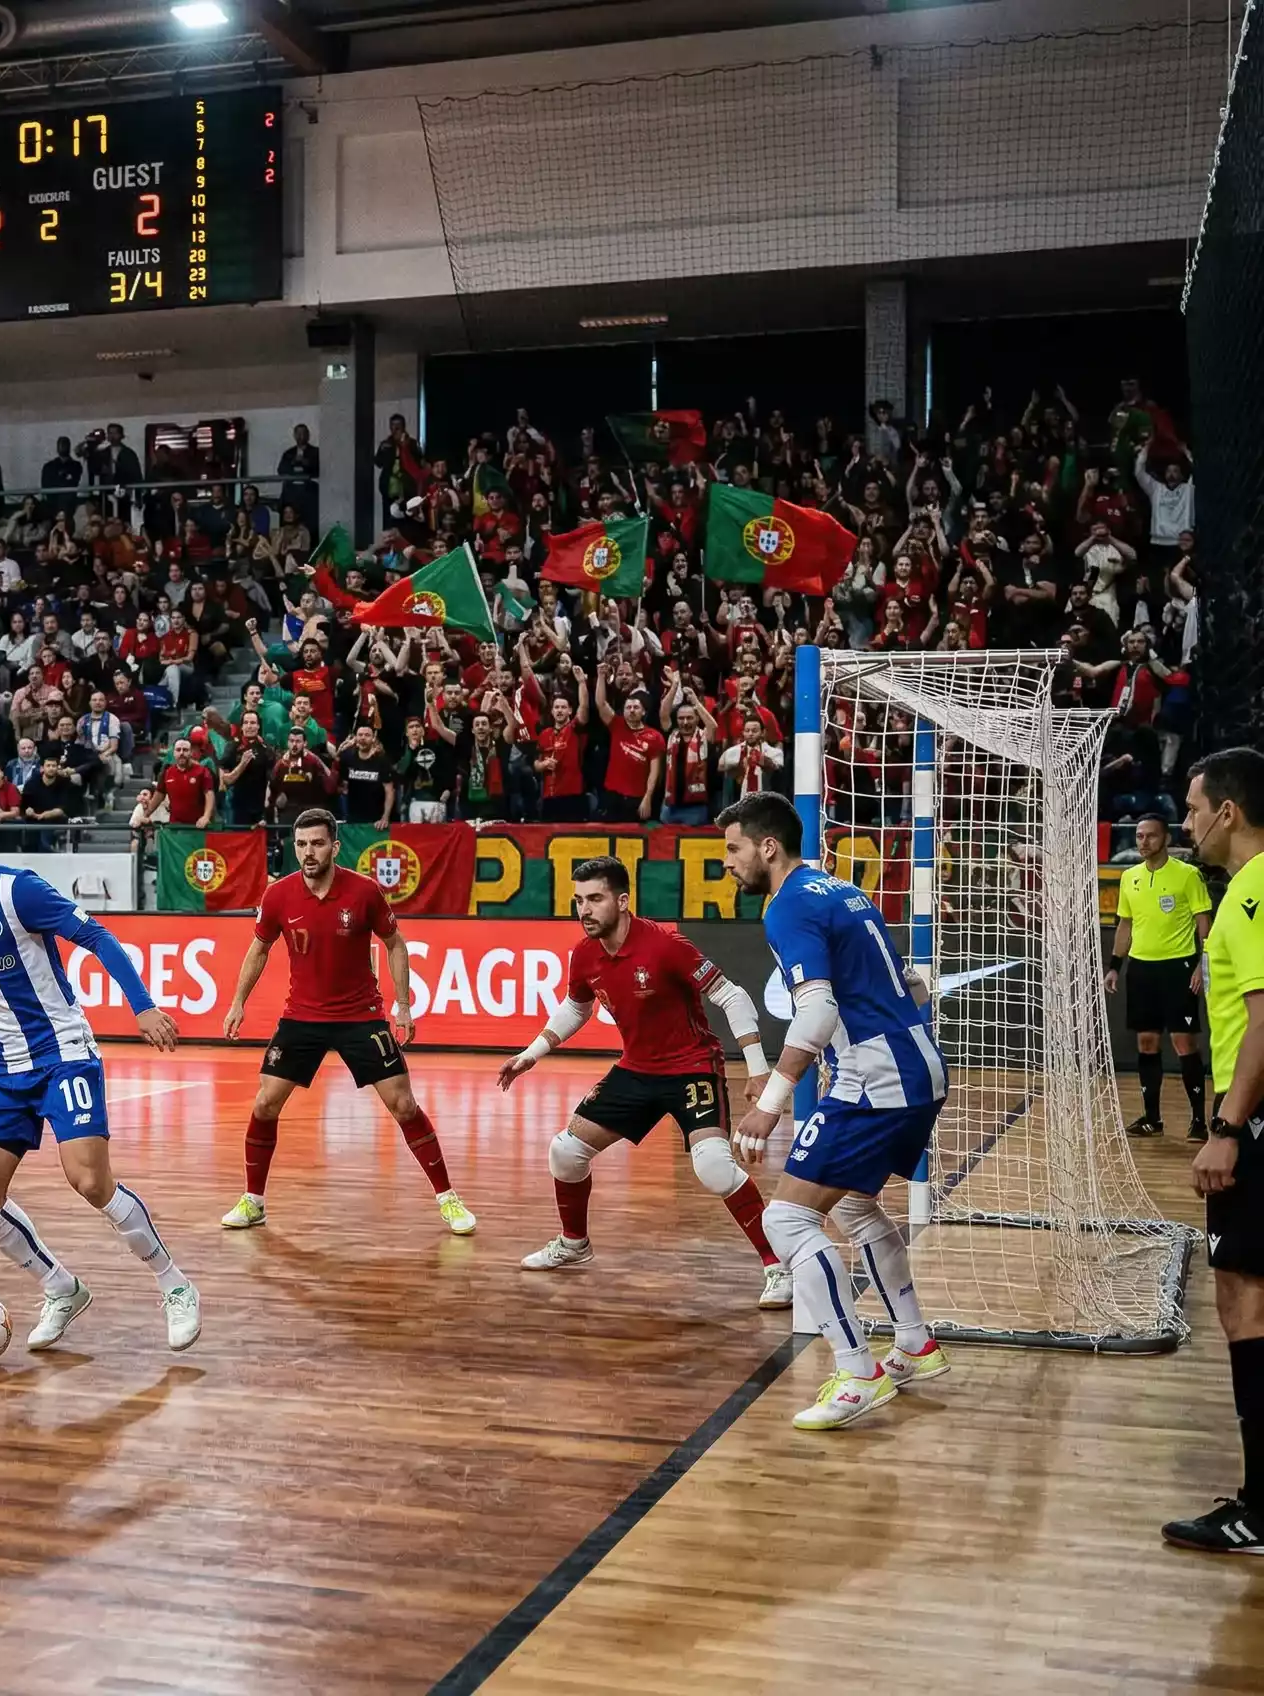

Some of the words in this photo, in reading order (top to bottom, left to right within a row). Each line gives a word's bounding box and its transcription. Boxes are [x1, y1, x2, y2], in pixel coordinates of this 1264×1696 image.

[19, 114, 107, 164] 0:17
[93, 162, 164, 191] GUEST
[40, 209, 58, 241] 2
[137, 194, 160, 235] 2
[108, 247, 161, 267] FAULTS
[110, 271, 162, 302] 3/4
[290, 928, 309, 955] 17
[390, 940, 616, 1025] SAGR
[370, 1030, 395, 1058] 17
[59, 1076, 93, 1112] 10
[685, 1081, 715, 1109] 33
